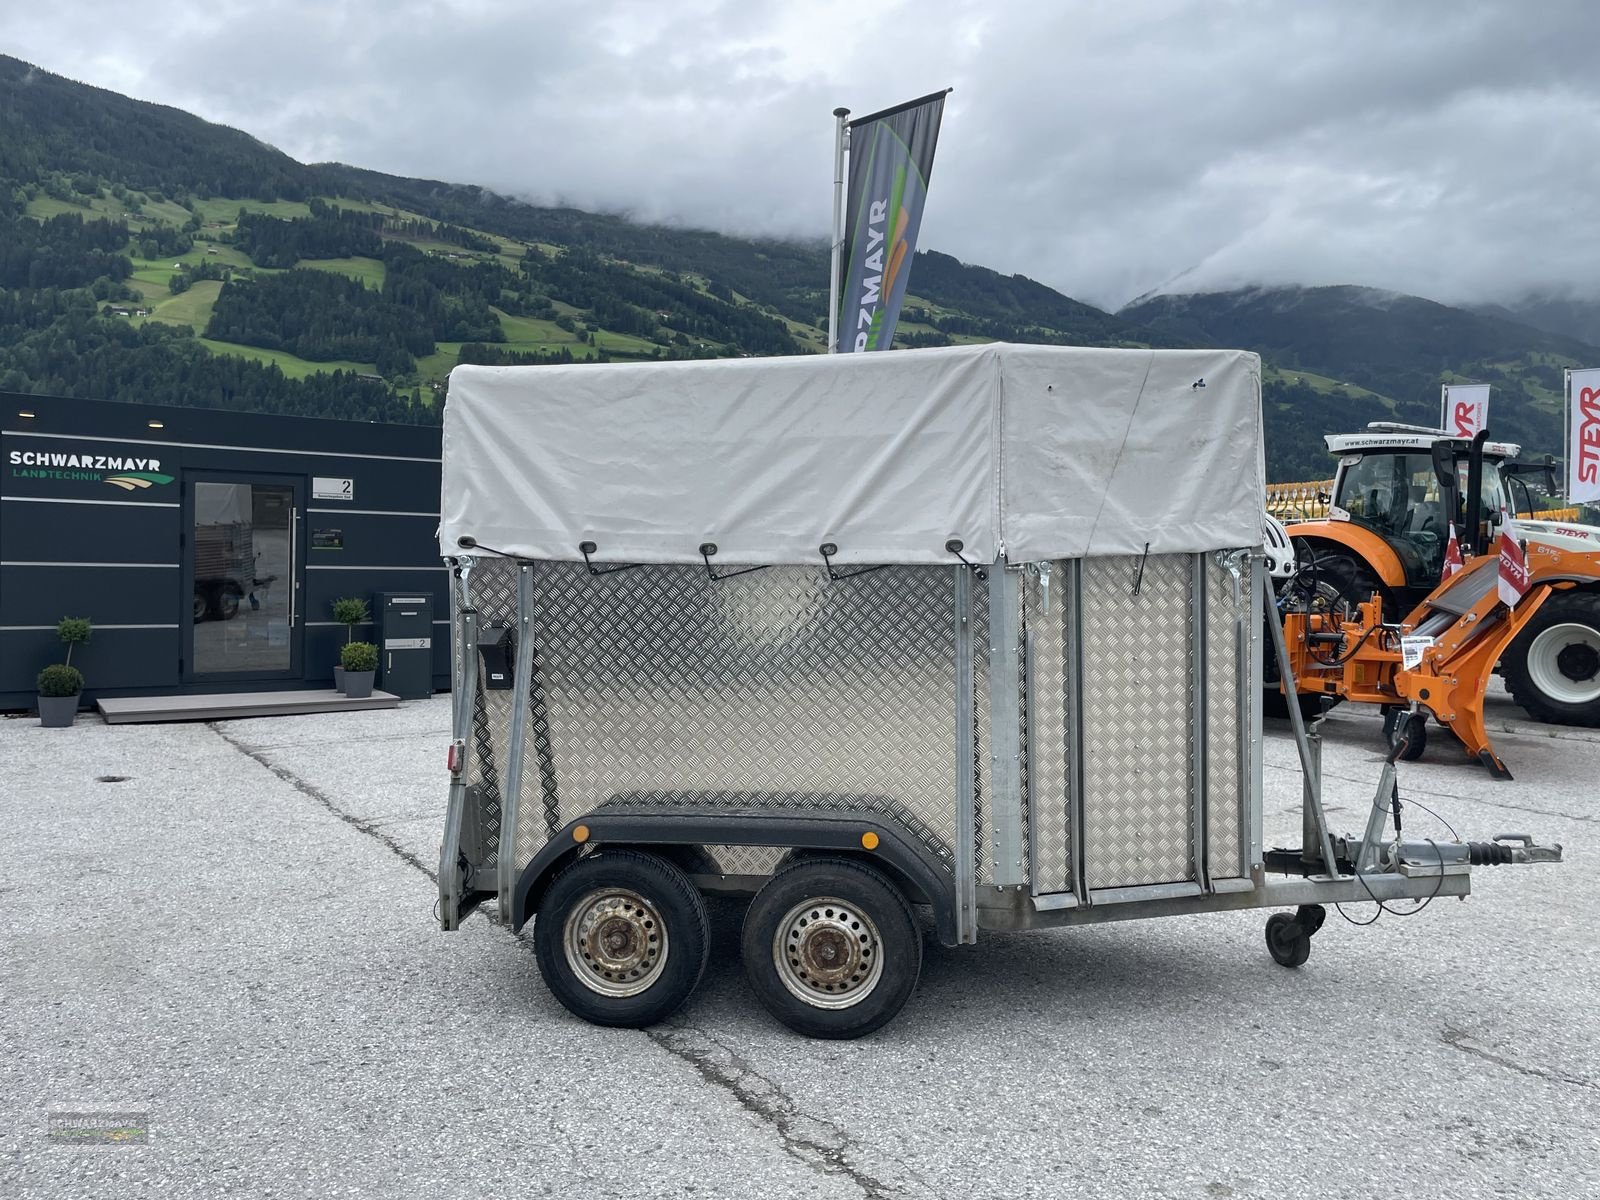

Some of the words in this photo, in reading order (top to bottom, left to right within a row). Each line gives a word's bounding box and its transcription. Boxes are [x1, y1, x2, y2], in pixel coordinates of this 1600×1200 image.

[1578, 386, 1600, 485] STEYR
[1344, 438, 1419, 447] www.schwarzmayr.at
[9, 451, 161, 472] SCHWARZMAYR
[13, 468, 102, 481] LANDTECHNIK
[342, 480, 351, 494] 2
[1553, 527, 1589, 539] STEYR
[419, 639, 426, 648] 2
